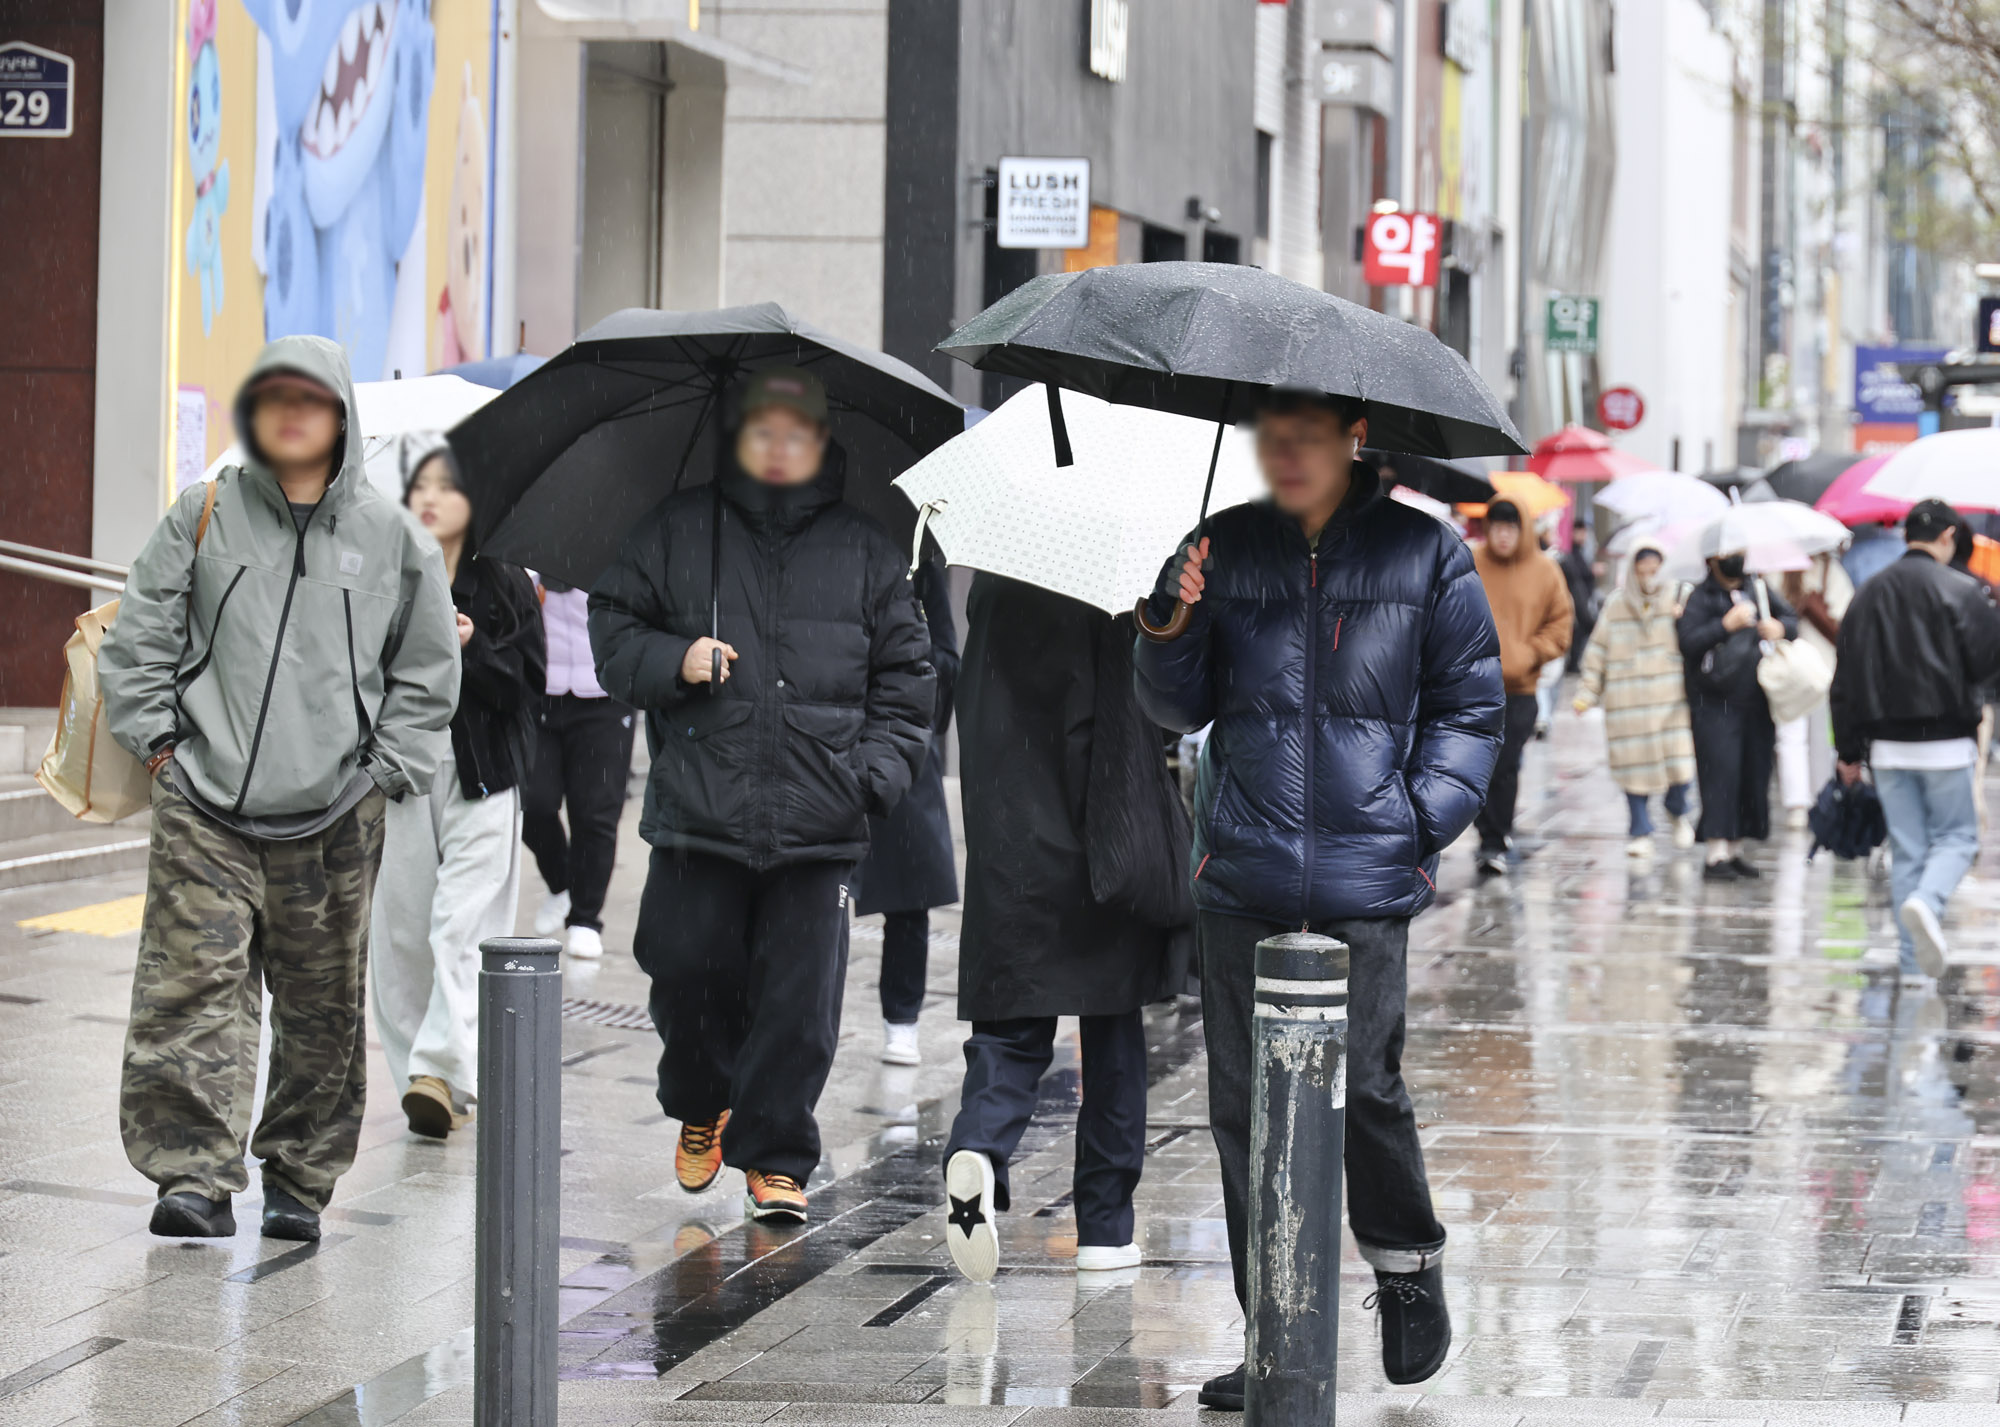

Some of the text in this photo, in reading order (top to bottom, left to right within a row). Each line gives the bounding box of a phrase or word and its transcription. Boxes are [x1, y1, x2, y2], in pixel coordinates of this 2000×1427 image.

[0, 90, 50, 126] 29
[1010, 174, 1079, 190] LUSH
[1371, 214, 1437, 286] 약
[1552, 299, 1595, 340] 약
